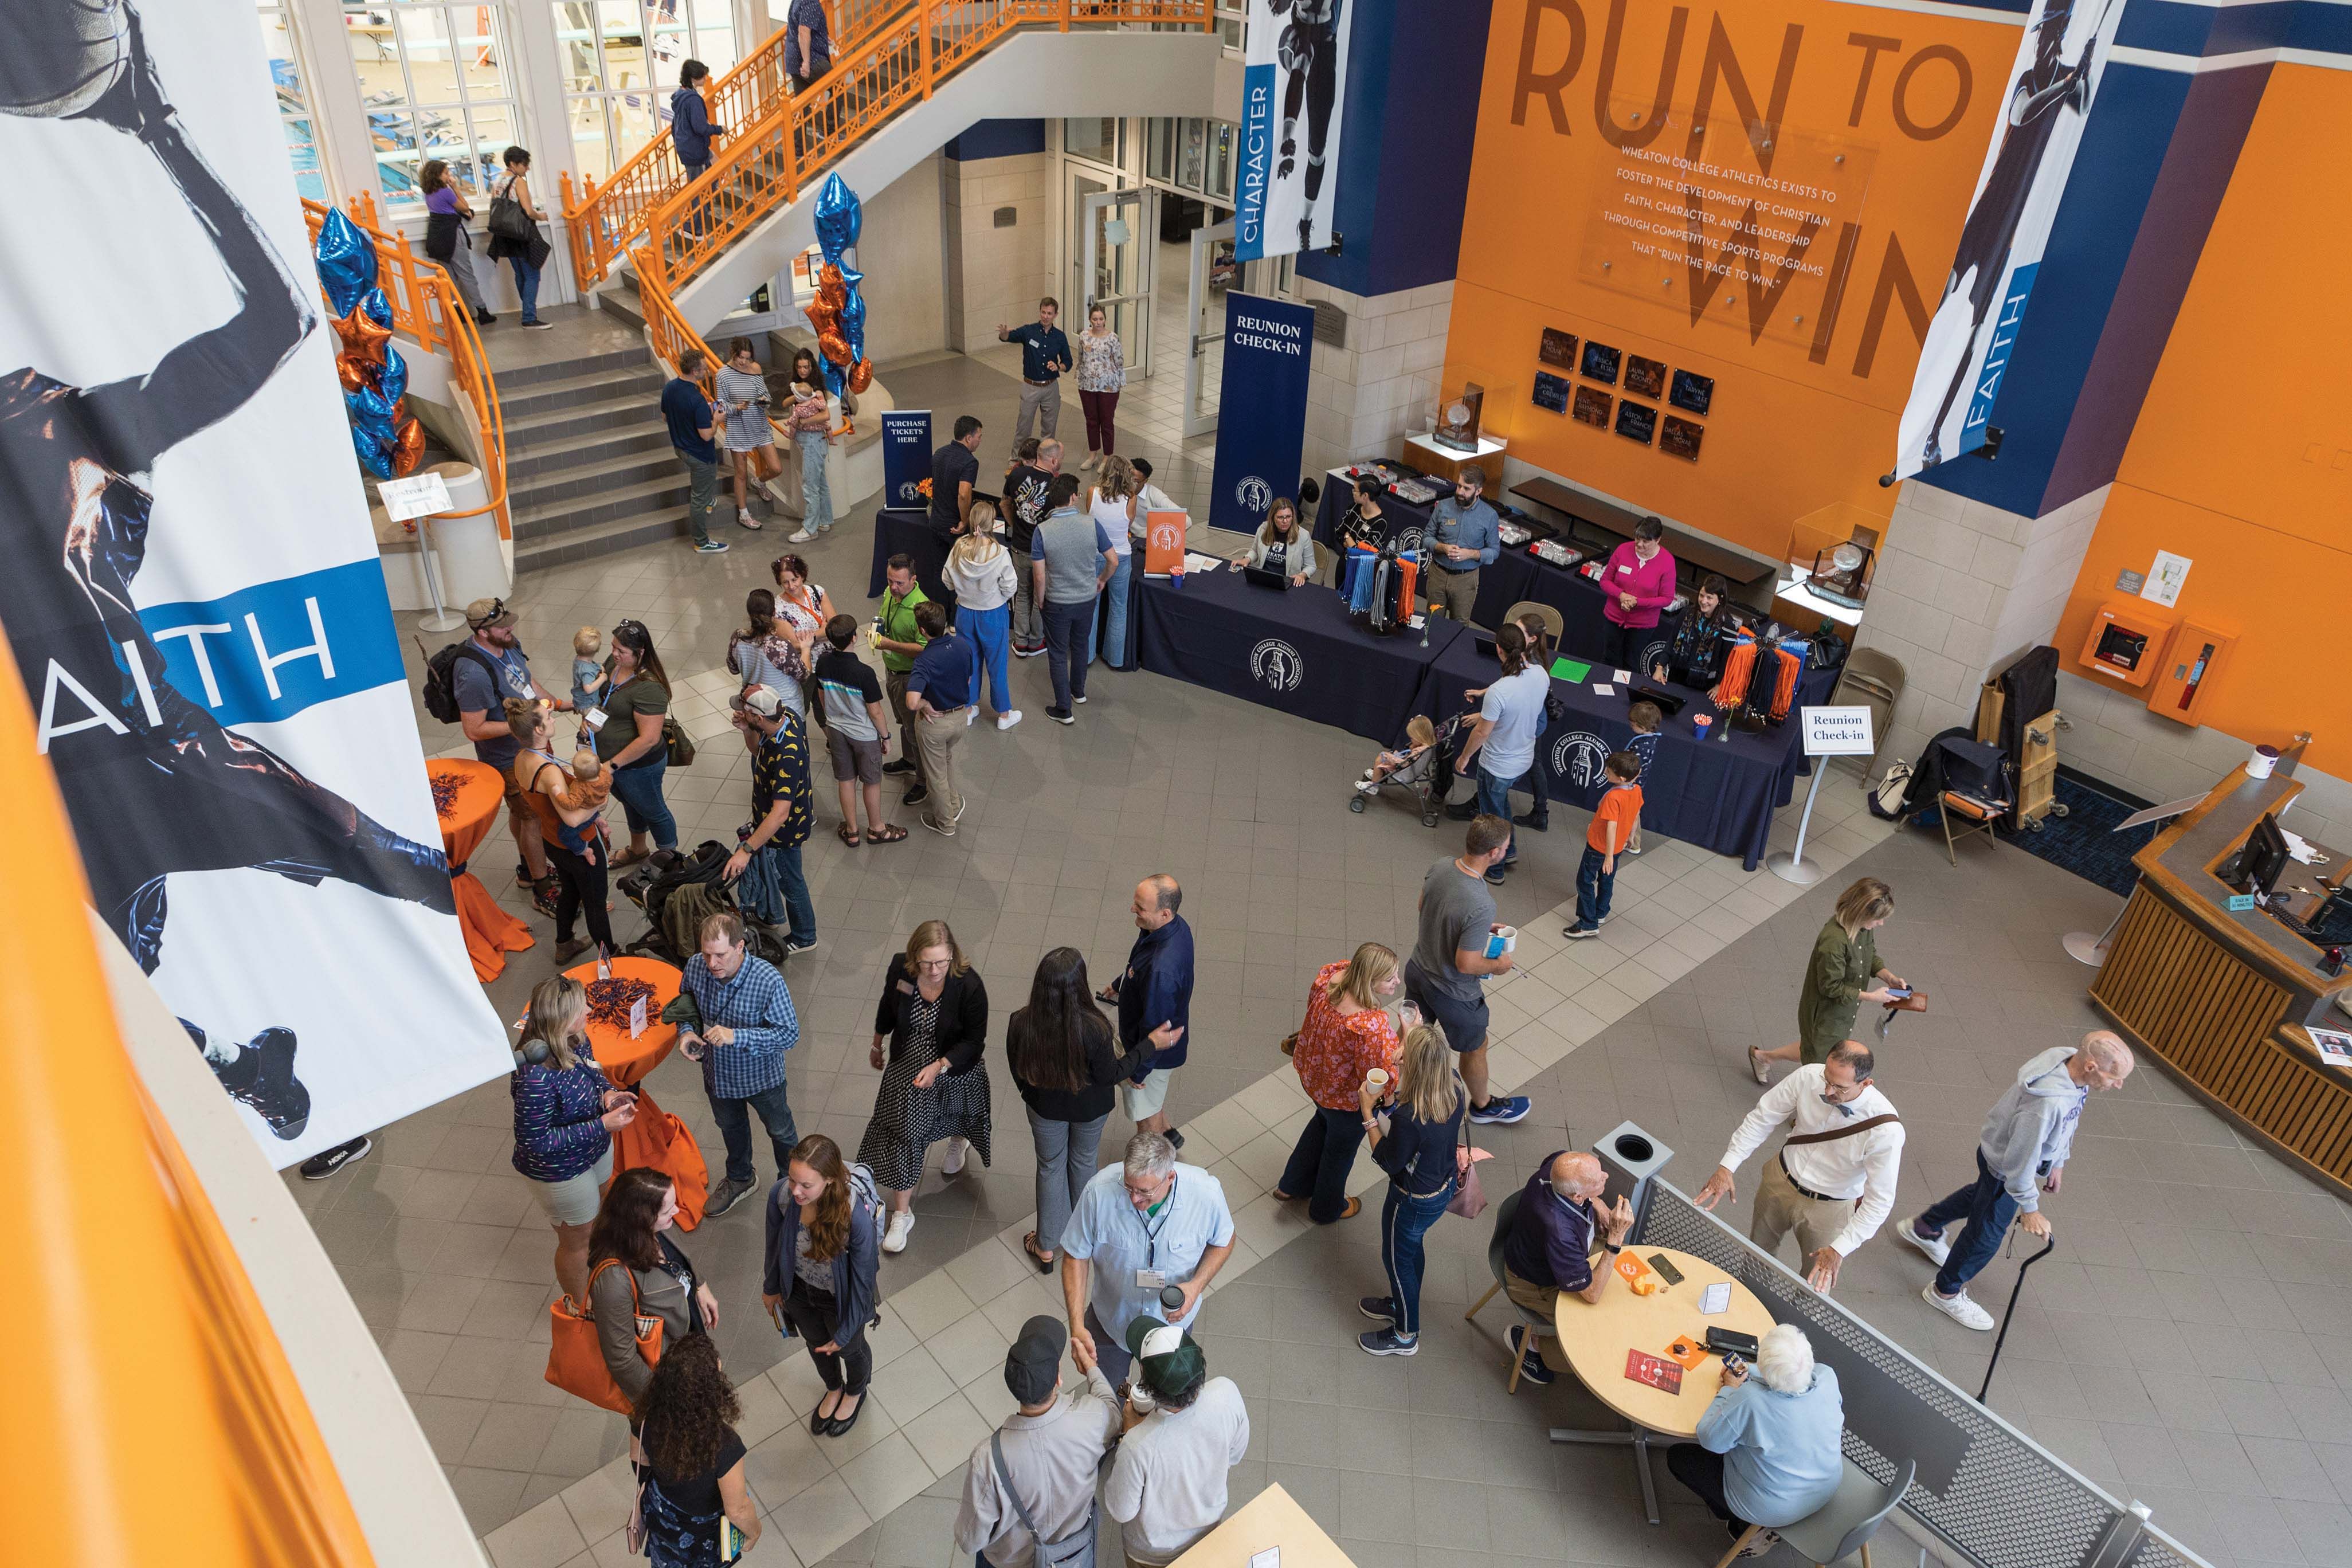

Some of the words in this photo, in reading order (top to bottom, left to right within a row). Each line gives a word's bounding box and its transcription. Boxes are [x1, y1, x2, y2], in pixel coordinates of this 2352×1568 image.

[1511, 0, 1804, 177] RUN
[1847, 32, 1973, 141] TO
[1244, 87, 1267, 243] CHARACTER
[1622, 146, 1670, 165] WHEATON
[1672, 157, 1720, 177] COLLEGE
[1722, 169, 1779, 190] ATHLETICS
[1781, 181, 1817, 199] EXISTS
[1821, 190, 1836, 202] TO
[1617, 168, 1653, 185] FOSTER
[1656, 177, 1674, 190] THE
[1676, 182, 1753, 209] DEVELOPMENT
[1754, 201, 1770, 211] OF
[1772, 205, 1830, 227] CHRISTIAN
[1624, 193, 1653, 210] FAITH,
[1656, 201, 1717, 226] CHARACTER,
[1720, 218, 1742, 230] AND
[1745, 223, 1810, 247] LEADERSHIP
[1604, 211, 1651, 231] THROUGH
[1652, 224, 1719, 249] COMPETITIVE
[1721, 242, 1761, 260] SPORTS
[1763, 252, 1824, 276] PROGRAMS
[1632, 241, 1655, 255] THAT
[1685, 256, 1703, 269] THE
[1706, 261, 1732, 276] RACE
[1735, 269, 1749, 280] TO
[1234, 332, 1301, 356] CHECK-IN
[1237, 315, 1301, 339] REUNION
[1967, 293, 2026, 429] FAITH
[1253, 652, 1261, 678] WHEATON
[1257, 641, 1276, 653] COLLEGE
[1277, 642, 1295, 657] ALUMNI
[1288, 657, 1300, 688] ASSOCIATION
[1814, 715, 1862, 724] Reunion
[1814, 730, 1864, 740] Check-in
[1555, 746, 1564, 774] WHEATON
[1560, 734, 1583, 746] COLLEGE
[1585, 736, 1606, 751] ALUMNI
[328, 1150, 348, 1166] HOKA
